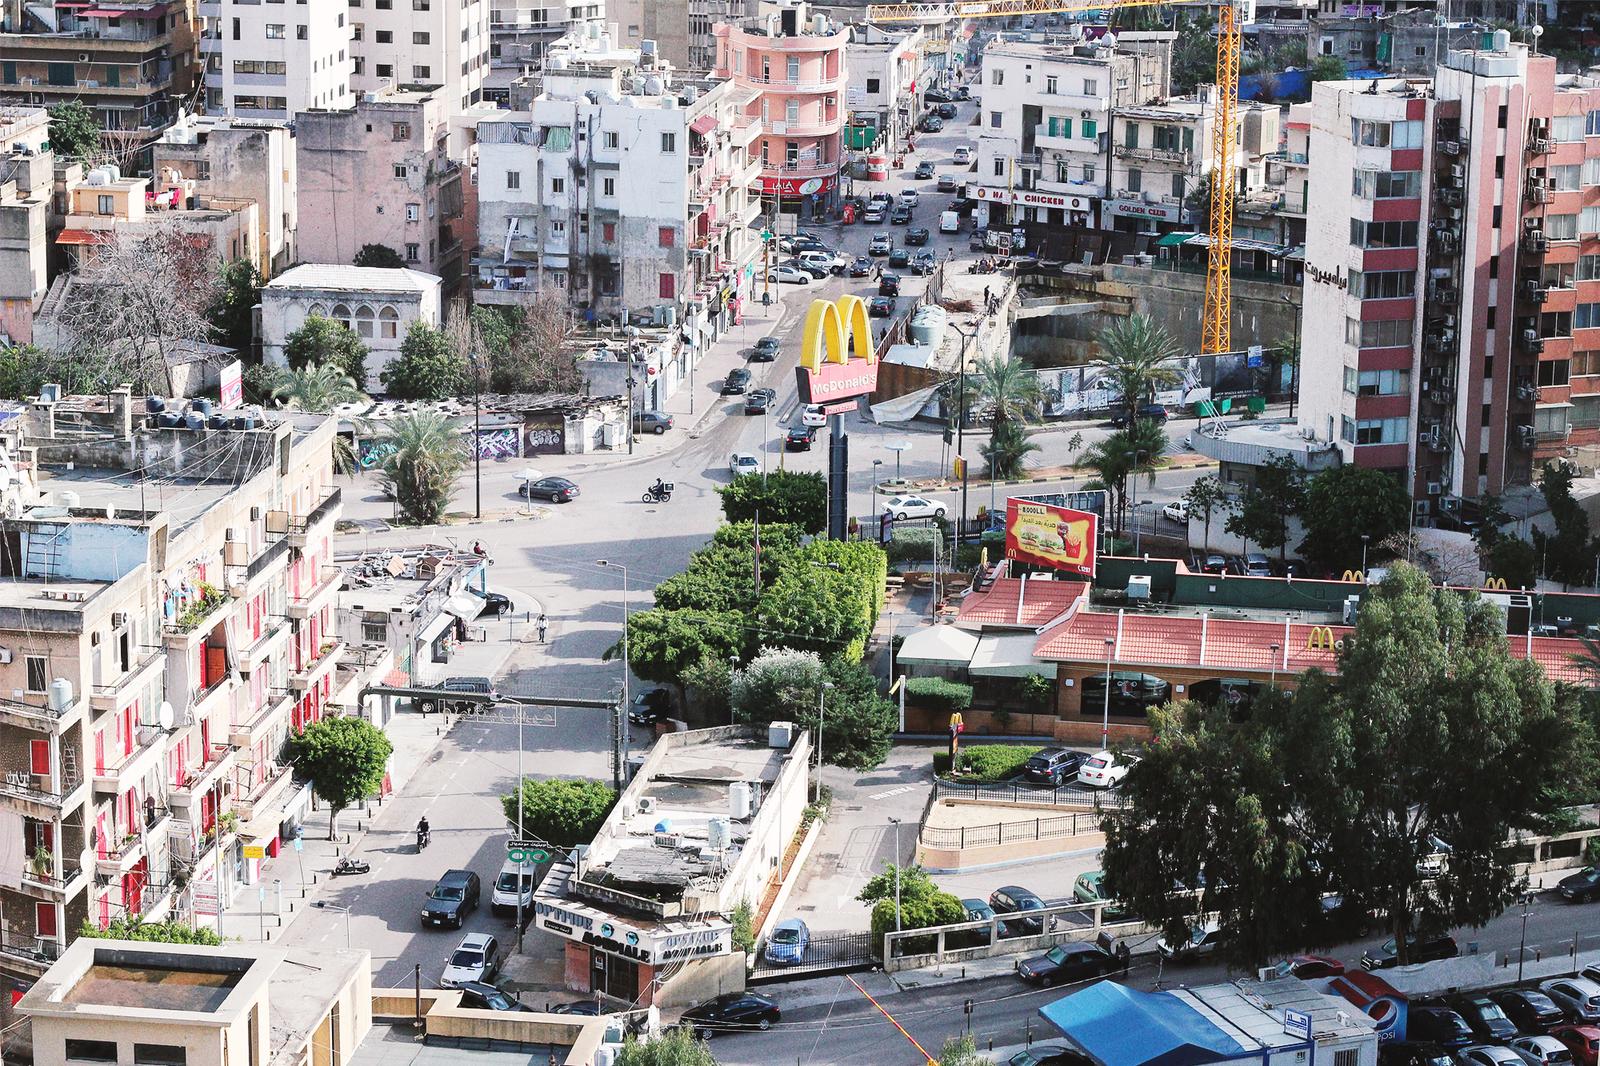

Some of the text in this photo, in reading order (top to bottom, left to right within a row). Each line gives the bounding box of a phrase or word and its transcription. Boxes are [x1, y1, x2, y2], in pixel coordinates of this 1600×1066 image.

[1024, 194, 1065, 206] CHICKEN
[1119, 204, 1145, 214] GOLDEN
[1148, 208, 1167, 217] CLUB
[812, 374, 876, 395] McDonald's
[535, 902, 593, 931] OPTIQUE
[582, 931, 651, 963] MONDIALE
[1377, 1030, 1396, 1043] epsi
